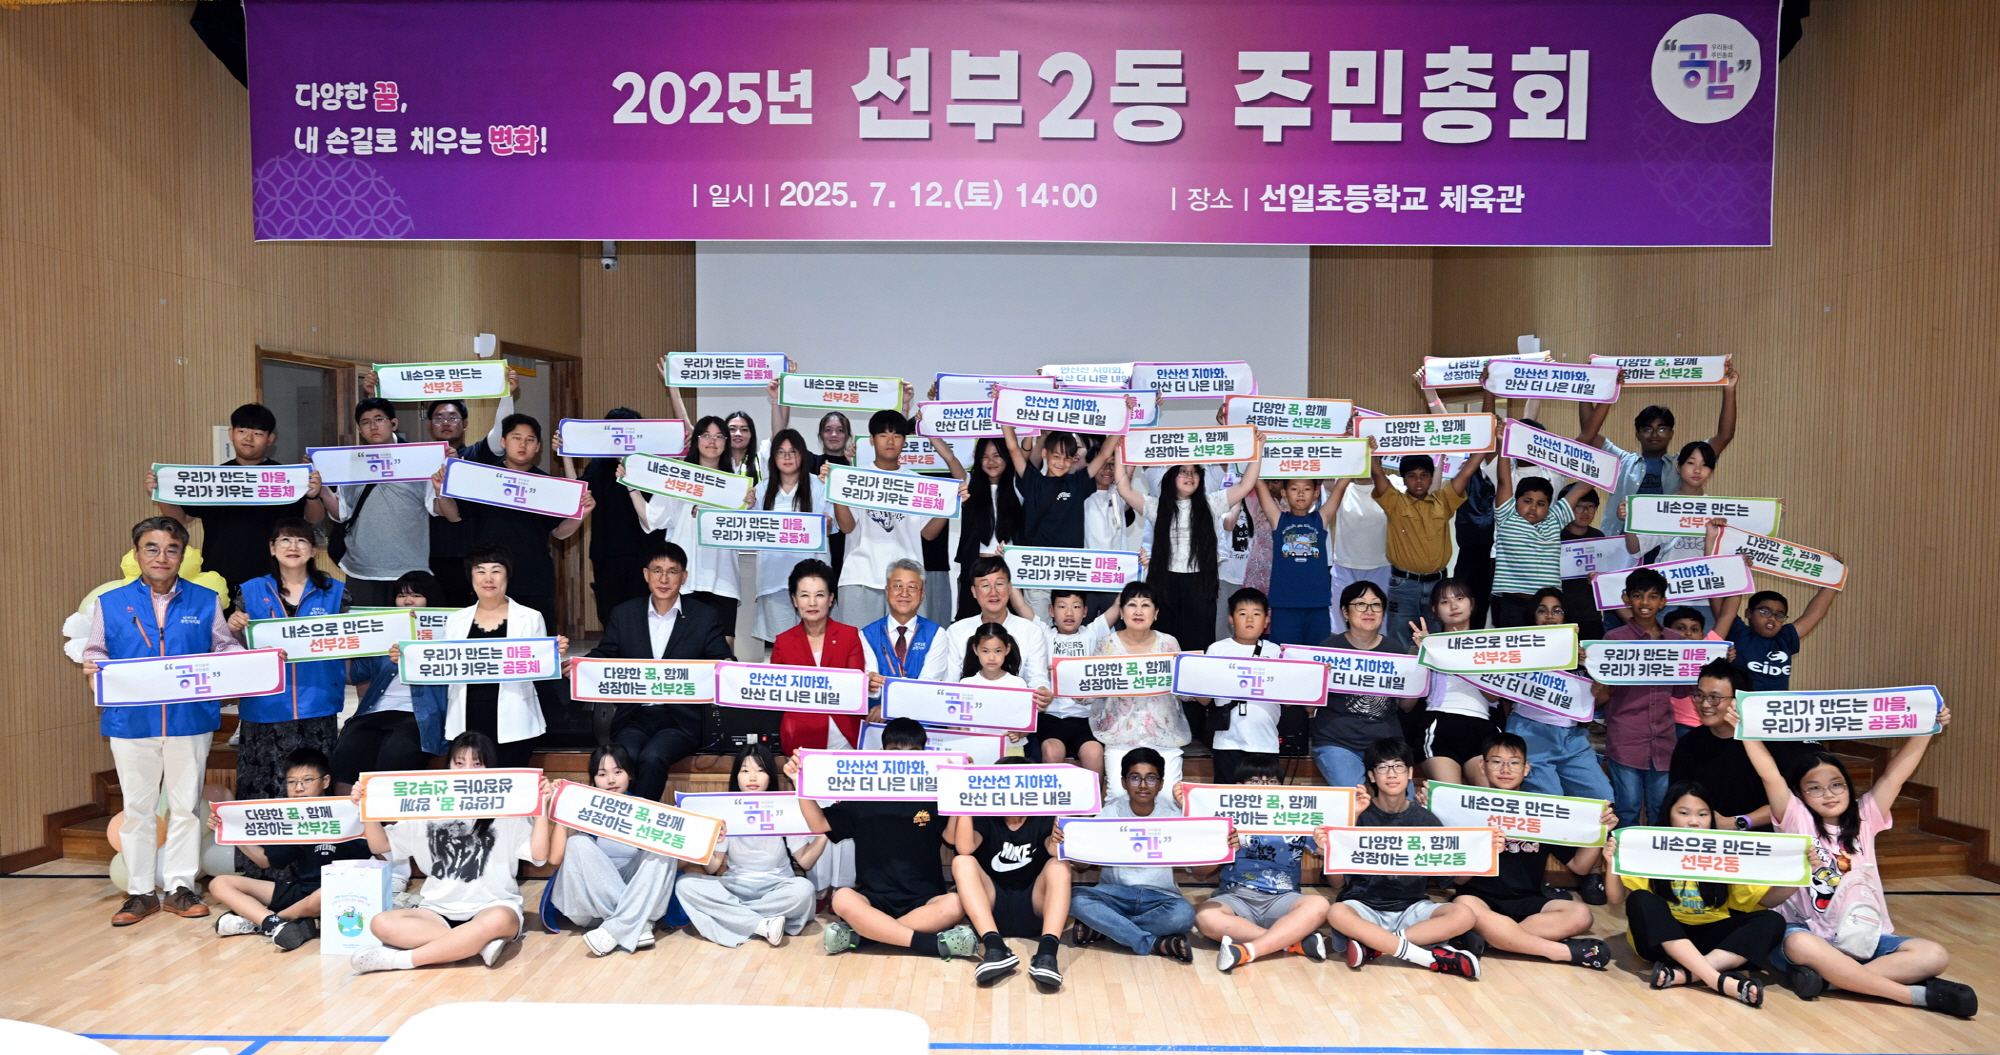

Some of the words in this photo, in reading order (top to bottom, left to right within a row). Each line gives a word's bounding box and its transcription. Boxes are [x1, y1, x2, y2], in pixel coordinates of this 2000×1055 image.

[294, 82, 368, 112] 다양한
[373, 81, 407, 114] 꿈,
[612, 69, 813, 125] 2025년
[851, 47, 1187, 142] 선부2동
[1234, 46, 1590, 144] 주민총회
[294, 127, 318, 154] 내
[325, 126, 397, 154] 손길로
[410, 126, 482, 154] 채우는
[488, 124, 548, 156] 변화!
[709, 184, 754, 206] 일시
[780, 182, 857, 207] 2025.
[870, 182, 896, 207] 7.
[910, 179, 1002, 210] 12.(토)
[1017, 183, 1097, 208] 14:00
[1187, 188, 1233, 210] 장소
[1259, 184, 1428, 213] 선일초등학교
[1440, 185, 1525, 213] 체육관
[684, 358, 713, 368] 우리가
[716, 358, 744, 368] 만드는
[747, 358, 769, 369] 마을,
[401, 368, 445, 382] 내손으로
[449, 367, 482, 380] 만드는
[681, 370, 710, 380] 우리가
[712, 370, 741, 380] 키우는
[744, 370, 773, 380] 공동체
[1156, 369, 1189, 379] 안산선
[1192, 368, 1227, 378] 지하화,
[1514, 367, 1548, 379] 안산선
[1552, 369, 1590, 382] 지하화,
[423, 381, 463, 394] 선부2동
[804, 378, 845, 390] 내손으로
[848, 381, 878, 392] 만드는
[1175, 381, 1186, 392] 더
[1189, 381, 1210, 391] 나은
[1213, 380, 1234, 391] 내일
[1505, 379, 1529, 391] 안산
[1532, 380, 1543, 391] 더
[1546, 381, 1568, 393] 나은
[1571, 382, 1595, 395] 내일
[822, 392, 859, 403] 선부2동
[1025, 396, 1059, 408] 안산선
[1062, 398, 1100, 413] 지하화,
[1017, 408, 1039, 420] 안산
[1042, 411, 1054, 422] 더
[1057, 412, 1080, 424] 나은
[1083, 414, 1106, 426] 내일
[1386, 422, 1420, 433] 다양한
[1424, 421, 1438, 433] 꿈,
[1442, 420, 1465, 432] 함께
[1150, 434, 1184, 444] 다양한
[1187, 432, 1202, 443] 꿈,
[1206, 432, 1228, 442] 함께
[1379, 436, 1425, 448] 성장하는
[1429, 434, 1471, 446] 선부2동
[1145, 446, 1189, 458] 성장하는
[1193, 444, 1234, 457] 선부2동
[178, 472, 216, 482] 우리가
[220, 472, 257, 482] 만드는
[262, 472, 290, 484] 마을,
[647, 461, 691, 481] 내손으로
[694, 472, 726, 488] 만드는
[174, 485, 212, 497] 우리가
[216, 485, 254, 497] 키우는
[258, 485, 294, 498] 공동체
[664, 478, 704, 497] 선부2동
[847, 474, 879, 487] 우리가
[882, 478, 914, 492] 만드는
[917, 482, 941, 497] 마을,
[842, 487, 875, 501] 우리가
[877, 491, 909, 505] 키우는
[912, 495, 945, 510] 공동체
[1657, 501, 1707, 514] 내손으로
[1711, 503, 1749, 516] 만드는
[716, 517, 746, 528] 우리가
[749, 518, 780, 530] 만드는
[783, 518, 806, 532] 마을,
[712, 530, 743, 542] 우리가
[746, 531, 776, 543] 키우는
[779, 533, 810, 544] 공동체
[1021, 554, 1055, 567] 우리가
[1058, 557, 1092, 569] 만드는
[1095, 557, 1121, 571] 마을,
[1017, 568, 1050, 580] 우리가
[1054, 570, 1086, 582] 키우는
[1090, 571, 1124, 584] 공동체
[282, 623, 338, 638] 내손으로
[343, 620, 384, 636] 만드는
[309, 636, 360, 652] 선부2동
[1448, 637, 1500, 650] 내손으로
[1505, 634, 1546, 647] 만드는
[423, 649, 461, 662] 우리가
[466, 648, 503, 660] 만드는
[507, 646, 535, 659] 마을,
[1473, 651, 1521, 664] 선부2동
[419, 663, 458, 677] 우리가
[462, 661, 499, 675] 키우는
[503, 660, 540, 674] 공동체
[604, 667, 641, 680] 다양한
[644, 668, 660, 681] 꿈,
[664, 668, 688, 680] 함께
[1085, 664, 1122, 676] 다양한
[1126, 662, 1142, 676] 꿈,
[1146, 661, 1171, 674] 함께
[598, 681, 647, 696] 성장하는
[651, 682, 696, 696] 선부2동
[750, 673, 787, 687] 안산선
[791, 675, 833, 690] 지하화,
[1079, 678, 1128, 691] 성장하는
[741, 687, 766, 700] 안산
[769, 689, 781, 701] 더
[786, 690, 810, 703] 나은
[815, 691, 840, 705] 내일
[1767, 700, 1815, 716] 우리가
[1820, 699, 1868, 715] 만드는
[1873, 697, 1910, 712] 마을,
[1762, 718, 1810, 733] 우리가
[1815, 716, 1863, 731] 키우는
[1868, 715, 1917, 730] 공동체
[968, 775, 1011, 789] 안산선
[1015, 774, 1062, 789] 지하화,
[959, 792, 987, 806] 안산
[992, 792, 1005, 806] 더
[1010, 792, 1038, 806] 나은
[1043, 792, 1071, 806] 내일
[1461, 795, 1519, 815] 내손으로
[1525, 801, 1570, 819] 만드는
[245, 808, 284, 820] 다양한
[287, 808, 304, 820] 꿈,
[308, 806, 333, 818] 함께
[590, 795, 633, 817] 다양한
[634, 806, 651, 822] 꿈,
[656, 813, 685, 831] 함께
[245, 823, 293, 836] 성장하는
[297, 822, 341, 834] 선부2동
[577, 808, 633, 834] 성장하는
[635, 825, 686, 849] 선부2동
[1487, 814, 1541, 834] 선부2동
[1359, 836, 1403, 850] 다양한
[1407, 837, 1426, 850] 꿈,
[1430, 836, 1459, 850] 함께
[1652, 836, 1717, 853] 내손으로
[1723, 840, 1771, 856] 만드는
[1000, 842, 1031, 862] NIKE
[1351, 852, 1409, 866] 성장하는
[1414, 852, 1466, 866] 선부2동
[1681, 855, 1739, 873] 선부2동
